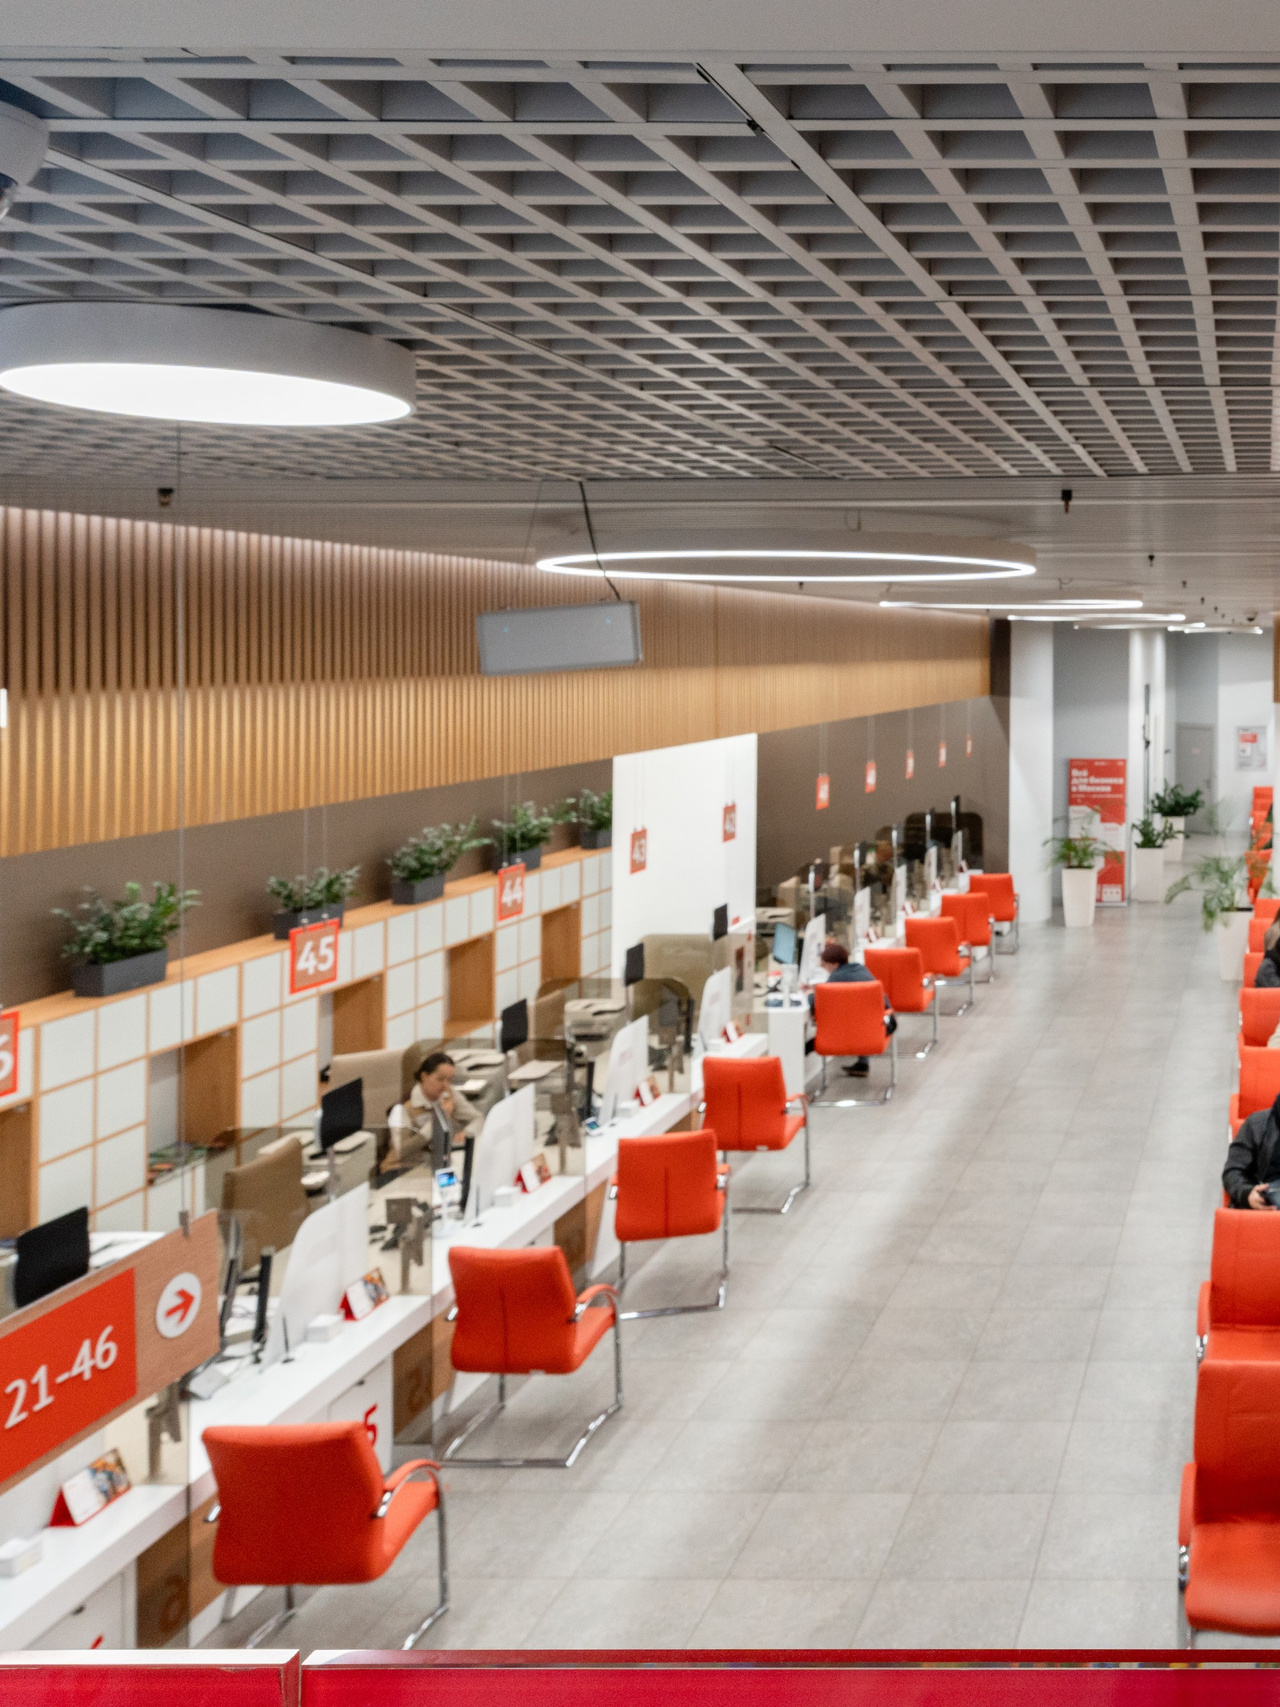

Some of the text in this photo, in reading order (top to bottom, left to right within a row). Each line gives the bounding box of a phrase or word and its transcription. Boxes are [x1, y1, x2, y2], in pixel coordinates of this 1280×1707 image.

[633, 838, 646, 864] 43
[502, 877, 522, 907] 44
[297, 935, 334, 975] 45
